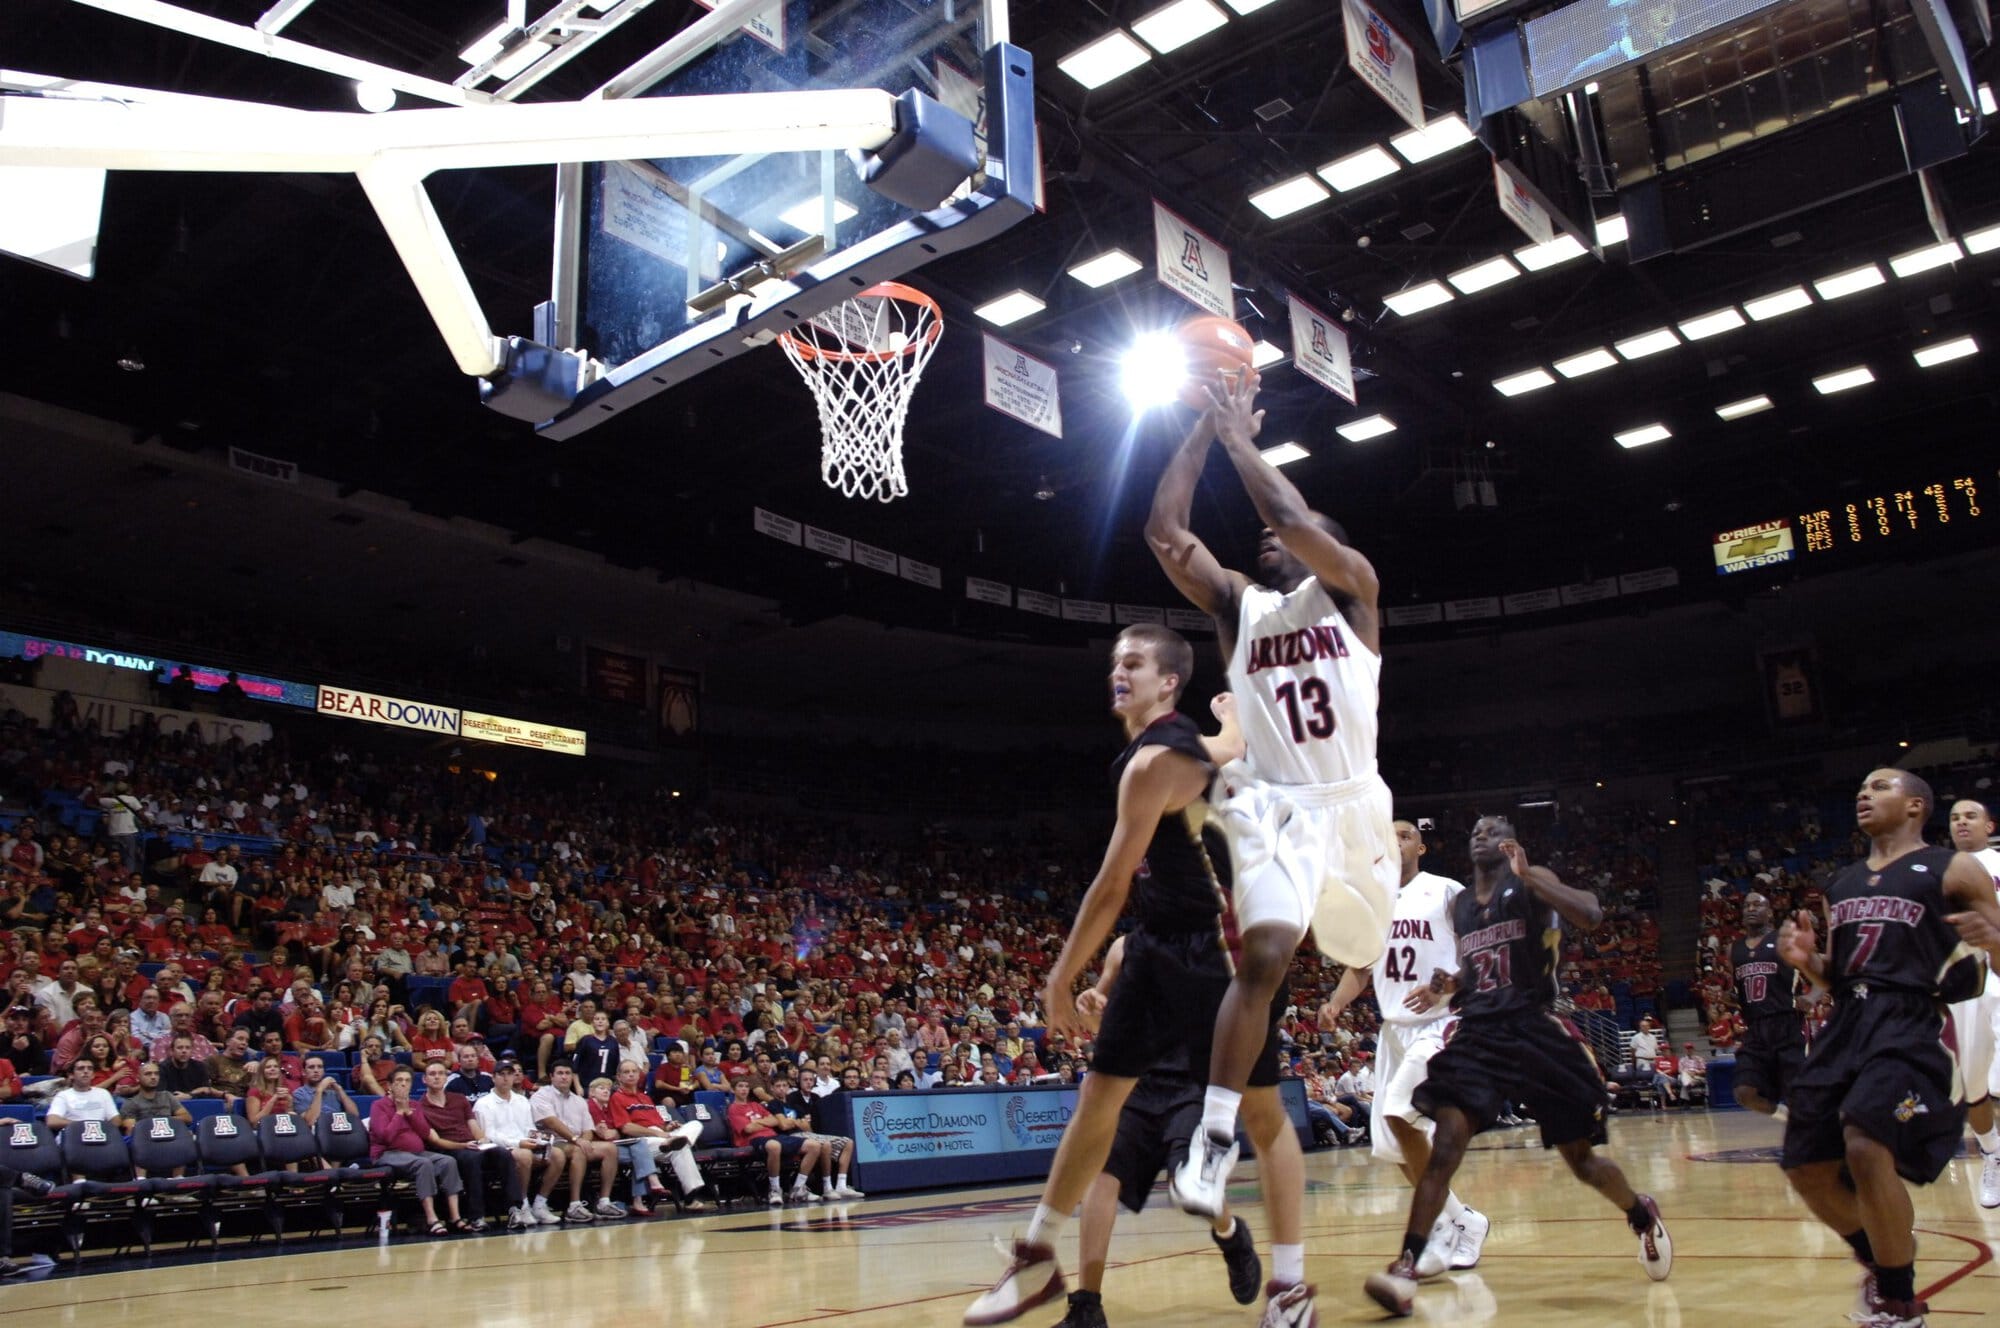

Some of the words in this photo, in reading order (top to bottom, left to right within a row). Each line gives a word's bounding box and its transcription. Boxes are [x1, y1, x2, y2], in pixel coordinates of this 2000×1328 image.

[1182, 230, 1208, 282] A
[1312, 318, 1333, 363] A
[1799, 510, 1830, 525] PLYR
[1867, 497, 1885, 509] 13
[1894, 490, 1914, 502] 34
[1923, 484, 1944, 496] 42
[1953, 477, 1975, 490] 54
[1806, 520, 1829, 533] PTS
[1965, 487, 1976, 497] 0
[1969, 506, 1981, 516] 0
[1718, 519, 1782, 543] O'RIELLY
[1806, 529, 1832, 543] RBS
[1724, 551, 1790, 574] WATSON
[1246, 626, 1350, 675] ARIZONA
[1275, 676, 1337, 744] 13
[1391, 919, 1434, 941] ZONA
[1461, 919, 1526, 957] ONCORDIA
[1844, 922, 1885, 977] 7
[1385, 945, 1418, 983] 42
[1472, 943, 1512, 993] 21
[598, 1048, 610, 1074] 7
[214, 1115, 237, 1136] A
[275, 1114, 297, 1134] A
[331, 1113, 352, 1131] A
[874, 1115, 926, 1132] DESERT
[927, 1112, 987, 1129] DIAMOND
[1016, 1108, 1059, 1124] DESERT
[10, 1123, 38, 1146] A
[81, 1121, 107, 1142] A
[150, 1117, 175, 1139] A
[897, 1142, 936, 1154] CASINO
[944, 1139, 974, 1150] HOTEL
